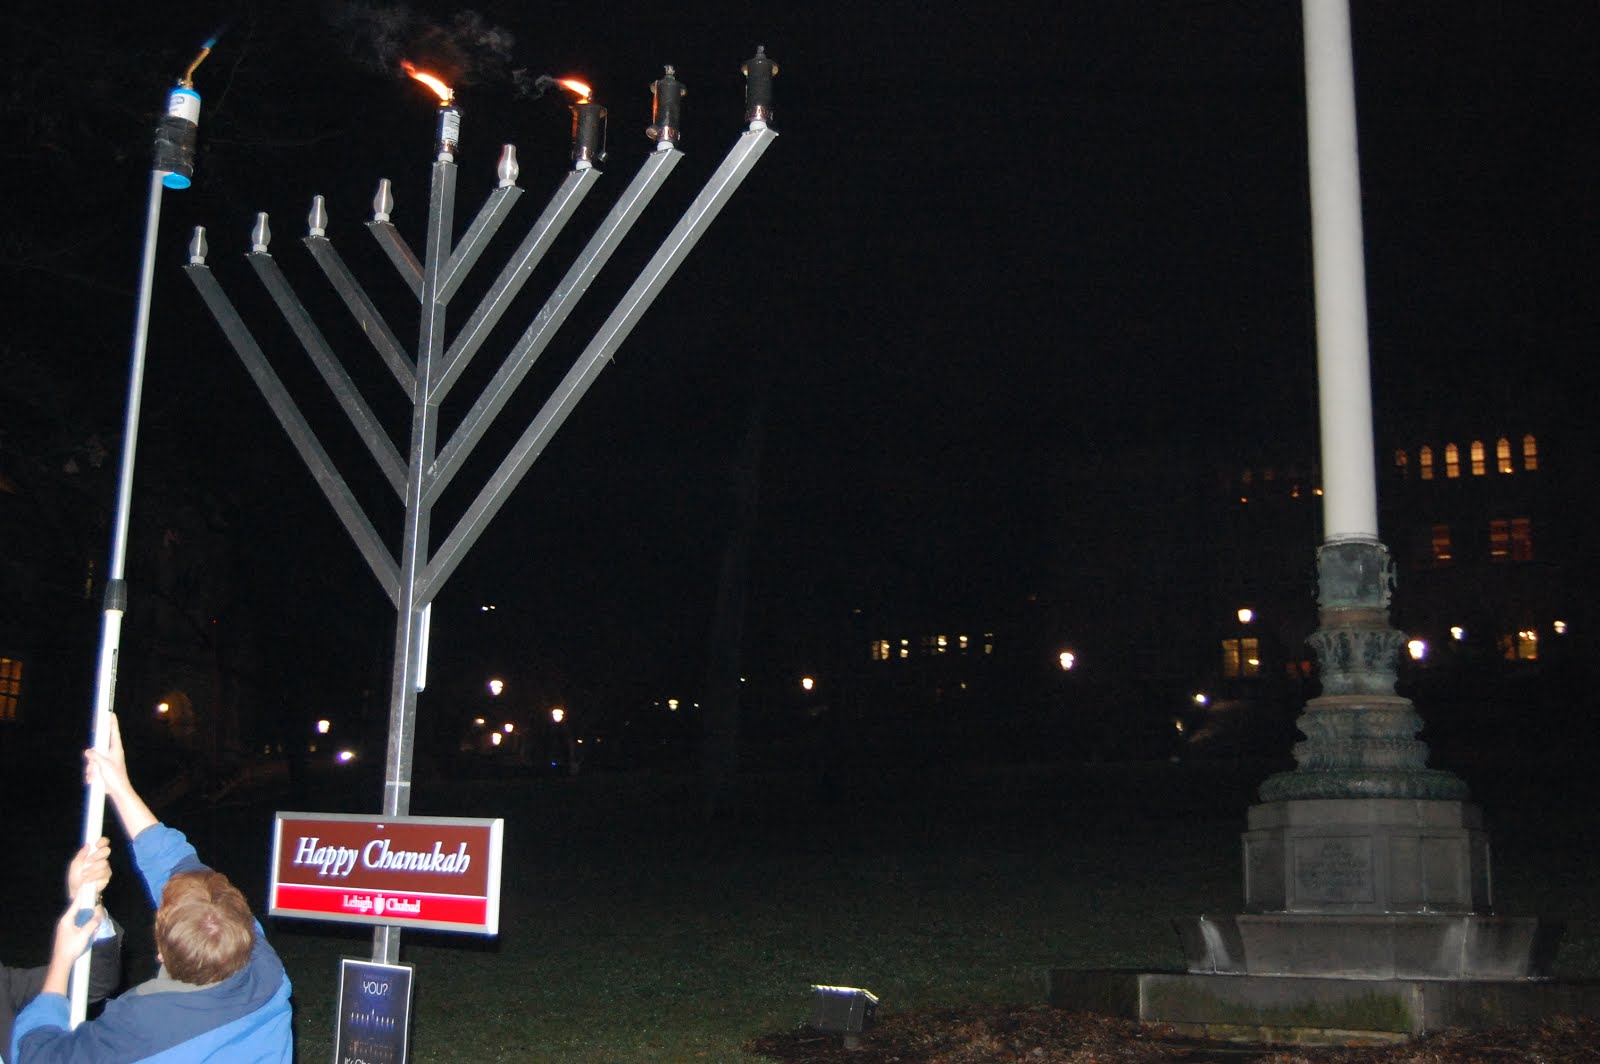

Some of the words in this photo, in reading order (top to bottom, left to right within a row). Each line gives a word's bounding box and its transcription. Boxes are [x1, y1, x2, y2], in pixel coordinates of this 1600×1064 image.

[293, 836, 359, 876] Happy
[362, 838, 471, 873] Chanukah
[342, 894, 373, 912] Lehigh
[385, 897, 421, 912] Chabad
[363, 980, 389, 996] YOU?
